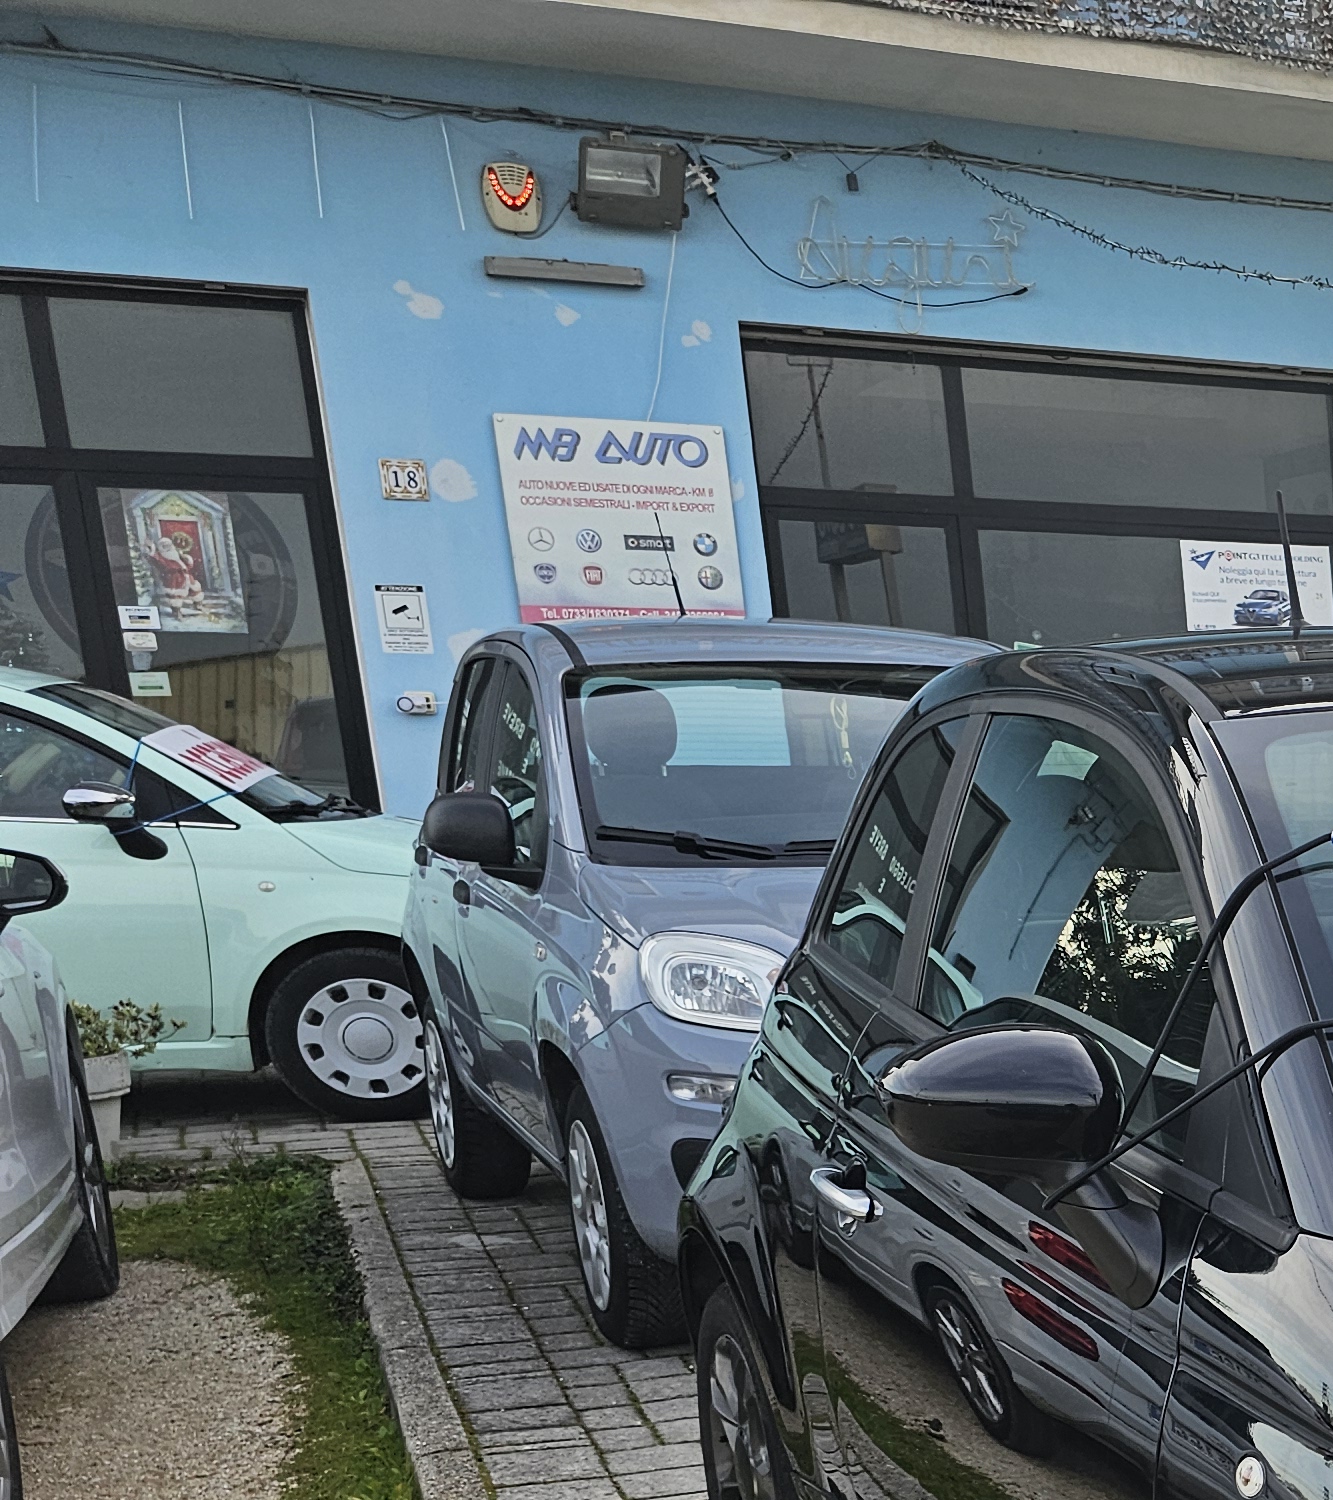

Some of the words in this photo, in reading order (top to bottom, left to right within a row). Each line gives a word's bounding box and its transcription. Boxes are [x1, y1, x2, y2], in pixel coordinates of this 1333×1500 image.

[513, 426, 581, 462] MB
[595, 429, 709, 468] AUTO
[391, 470, 419, 489] 18
[519, 480, 544, 490] AUTO
[545, 481, 577, 491] NUOVE
[578, 482, 591, 491] ED
[592, 483, 621, 493] USATE
[622, 484, 630, 493] DI
[632, 485, 654, 494] OGNI
[655, 486, 688, 496] MARCA
[692, 487, 706, 497] KM
[520, 496, 572, 506] OCCASIONI
[573, 497, 630, 509] SEMESTRALI
[636, 501, 670, 511] IMPORT
[672, 502, 678, 511] &
[680, 502, 715, 513] EXPORT
[1218, 566, 1252, 576] Noleggia
[1254, 567, 1266, 576] qui
[1267, 568, 1274, 576] la
[1225, 576, 1247, 584] breve
